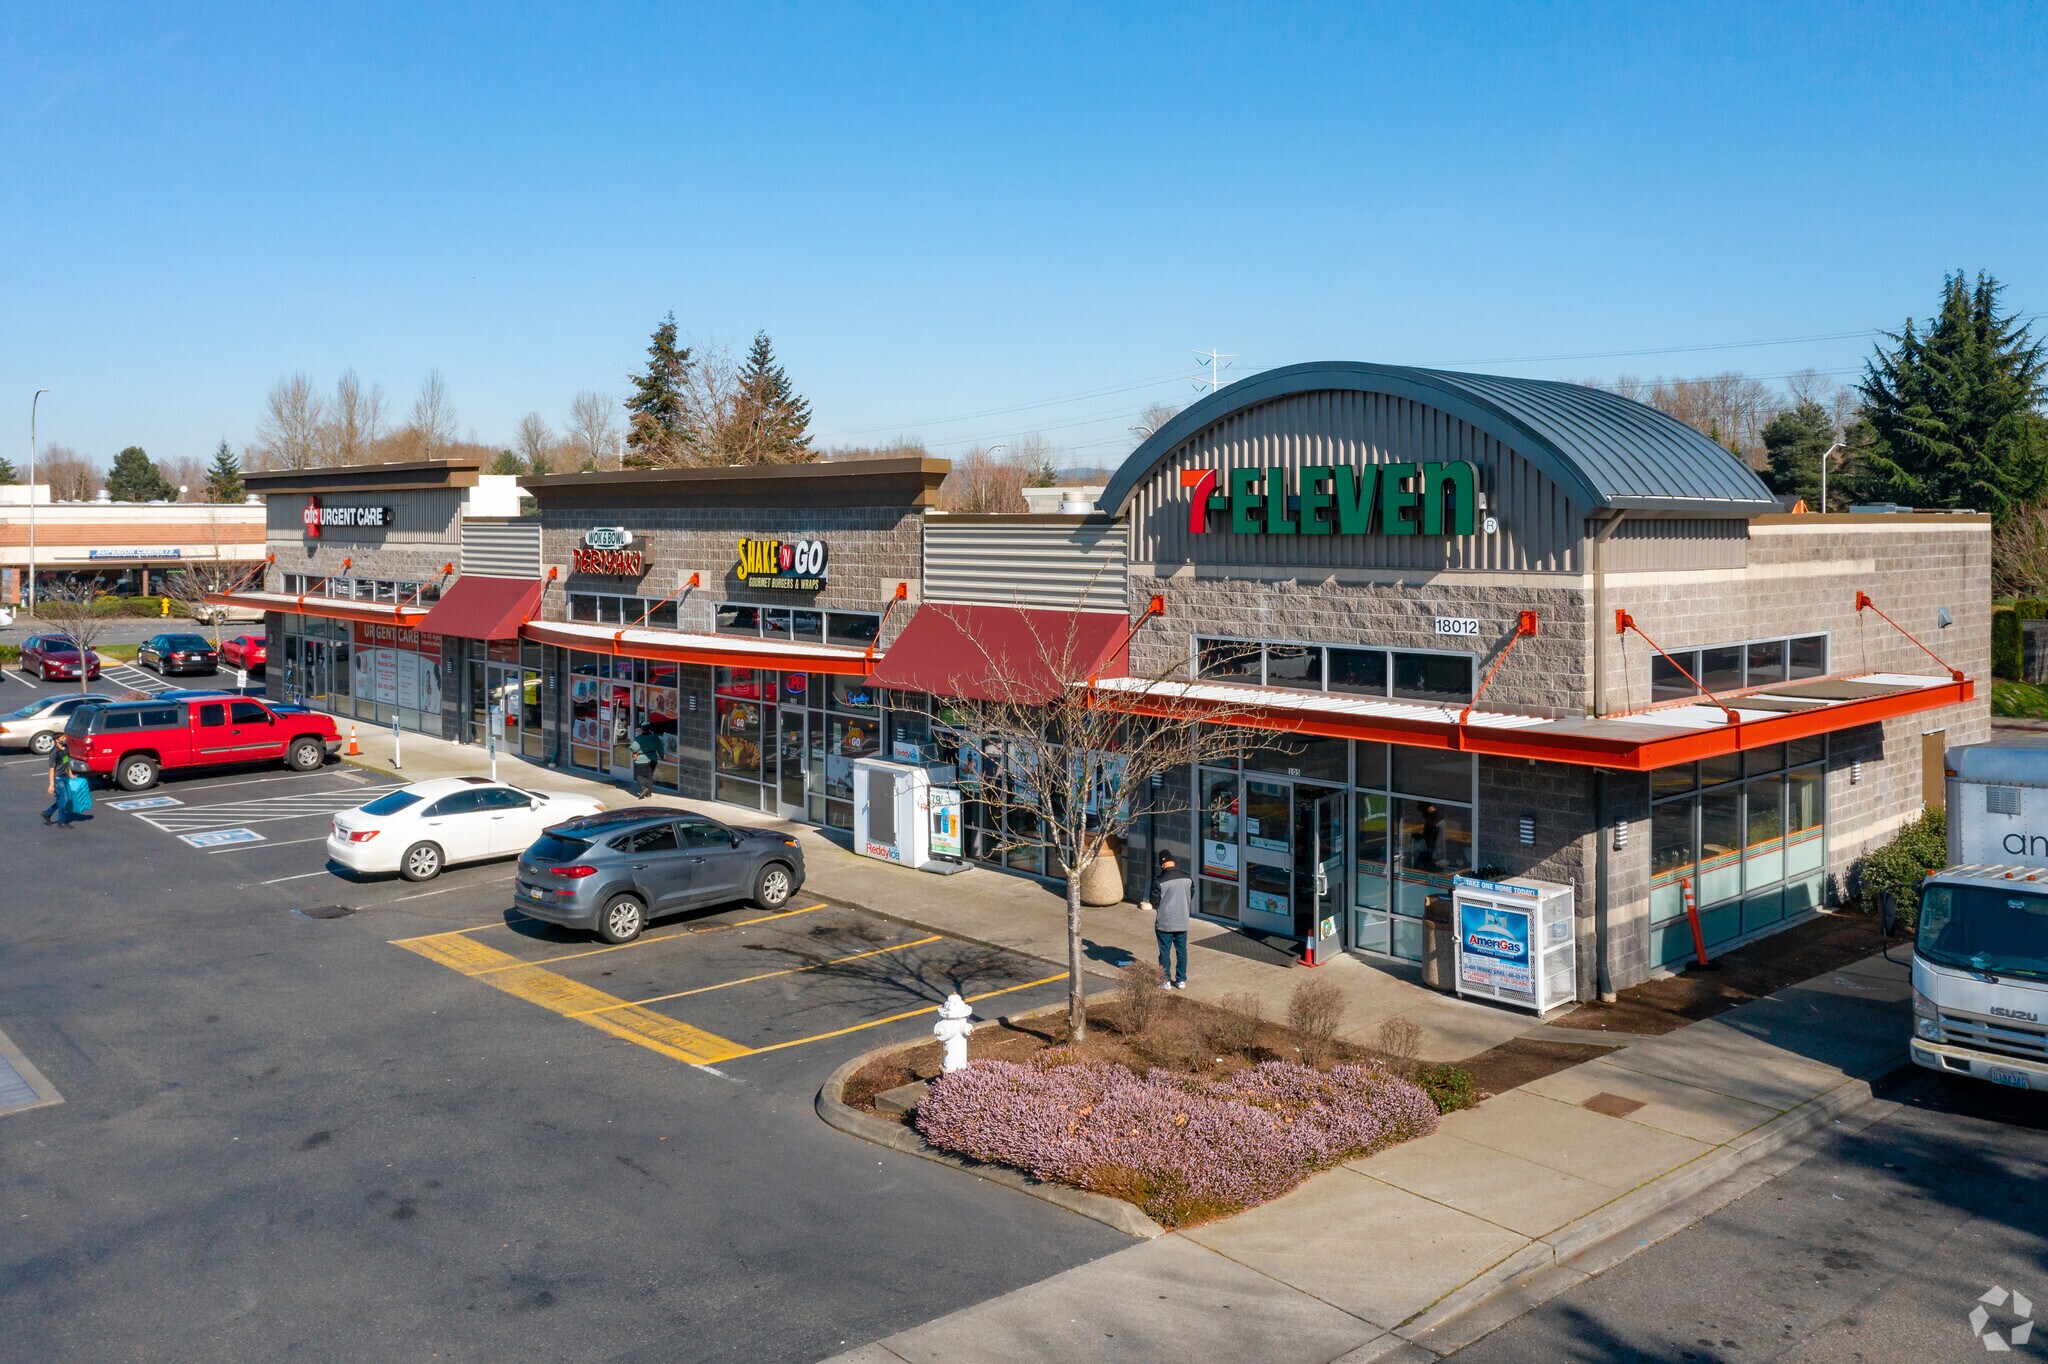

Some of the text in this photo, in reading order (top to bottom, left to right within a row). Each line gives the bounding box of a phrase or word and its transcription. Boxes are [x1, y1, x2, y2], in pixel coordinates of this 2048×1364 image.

[1181, 460, 1476, 535] 7-ELEVEN
[304, 504, 383, 525] afc URGENT CARE
[589, 532, 624, 544] WOK & BOWL
[573, 548, 641, 576] TERIYAKI
[737, 538, 778, 580] SHAKE
[795, 540, 823, 574] GO
[749, 577, 819, 590] GOURMET BURGERS & WRAPS
[1436, 619, 1477, 634] 18012
[786, 675, 807, 690] OPEN
[1466, 879, 1535, 897] TAKE ONE HOME TODAY!
[1469, 934, 1521, 953] AmeriGas
[1990, 1006, 2038, 1022] ISUZU
